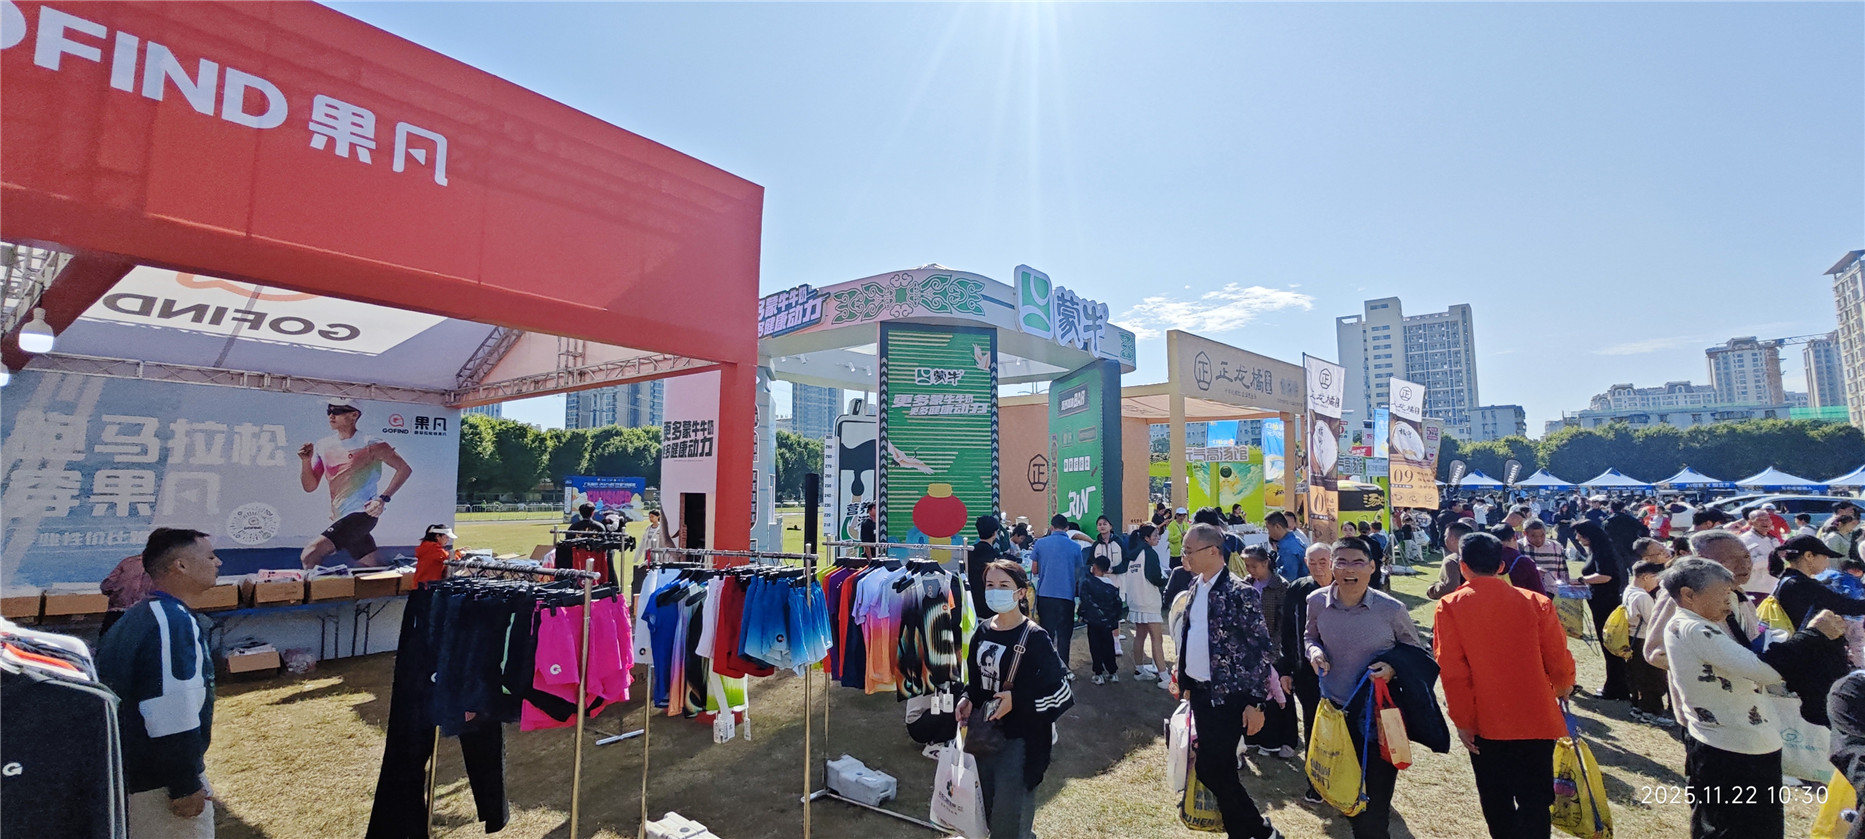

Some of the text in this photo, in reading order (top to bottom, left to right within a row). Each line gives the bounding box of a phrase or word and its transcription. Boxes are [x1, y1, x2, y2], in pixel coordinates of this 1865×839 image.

[309, 93, 448, 187] 果凡
[1057, 291, 1105, 351] 蒙牛
[934, 370, 961, 384] 蒙牛
[382, 427, 409, 435] GOFIND
[414, 415, 447, 431] 果凡
